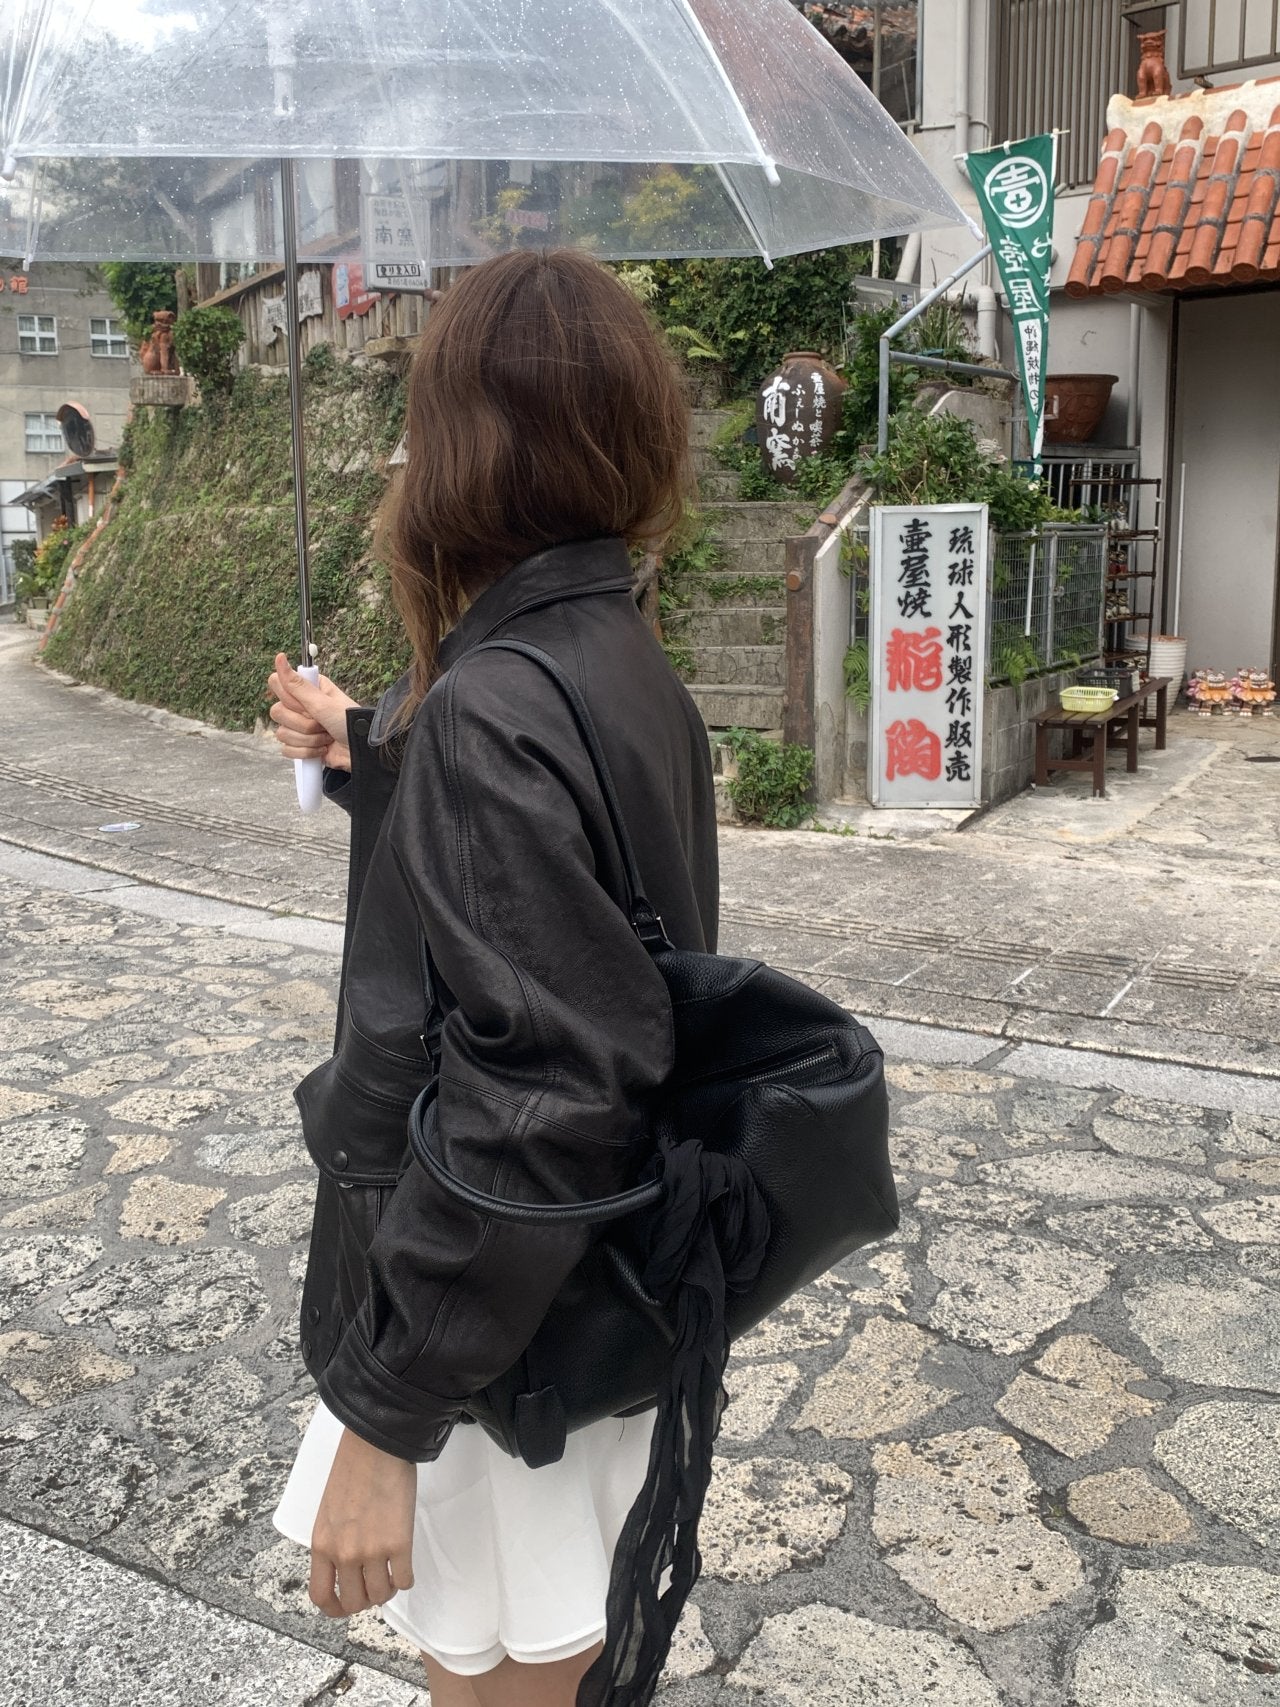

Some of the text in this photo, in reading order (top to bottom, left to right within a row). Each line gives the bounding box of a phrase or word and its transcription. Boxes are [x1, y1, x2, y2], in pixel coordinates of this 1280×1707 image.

[0, 276, 28, 294] 館
[945, 526, 974, 782] 琉球人形製作販売
